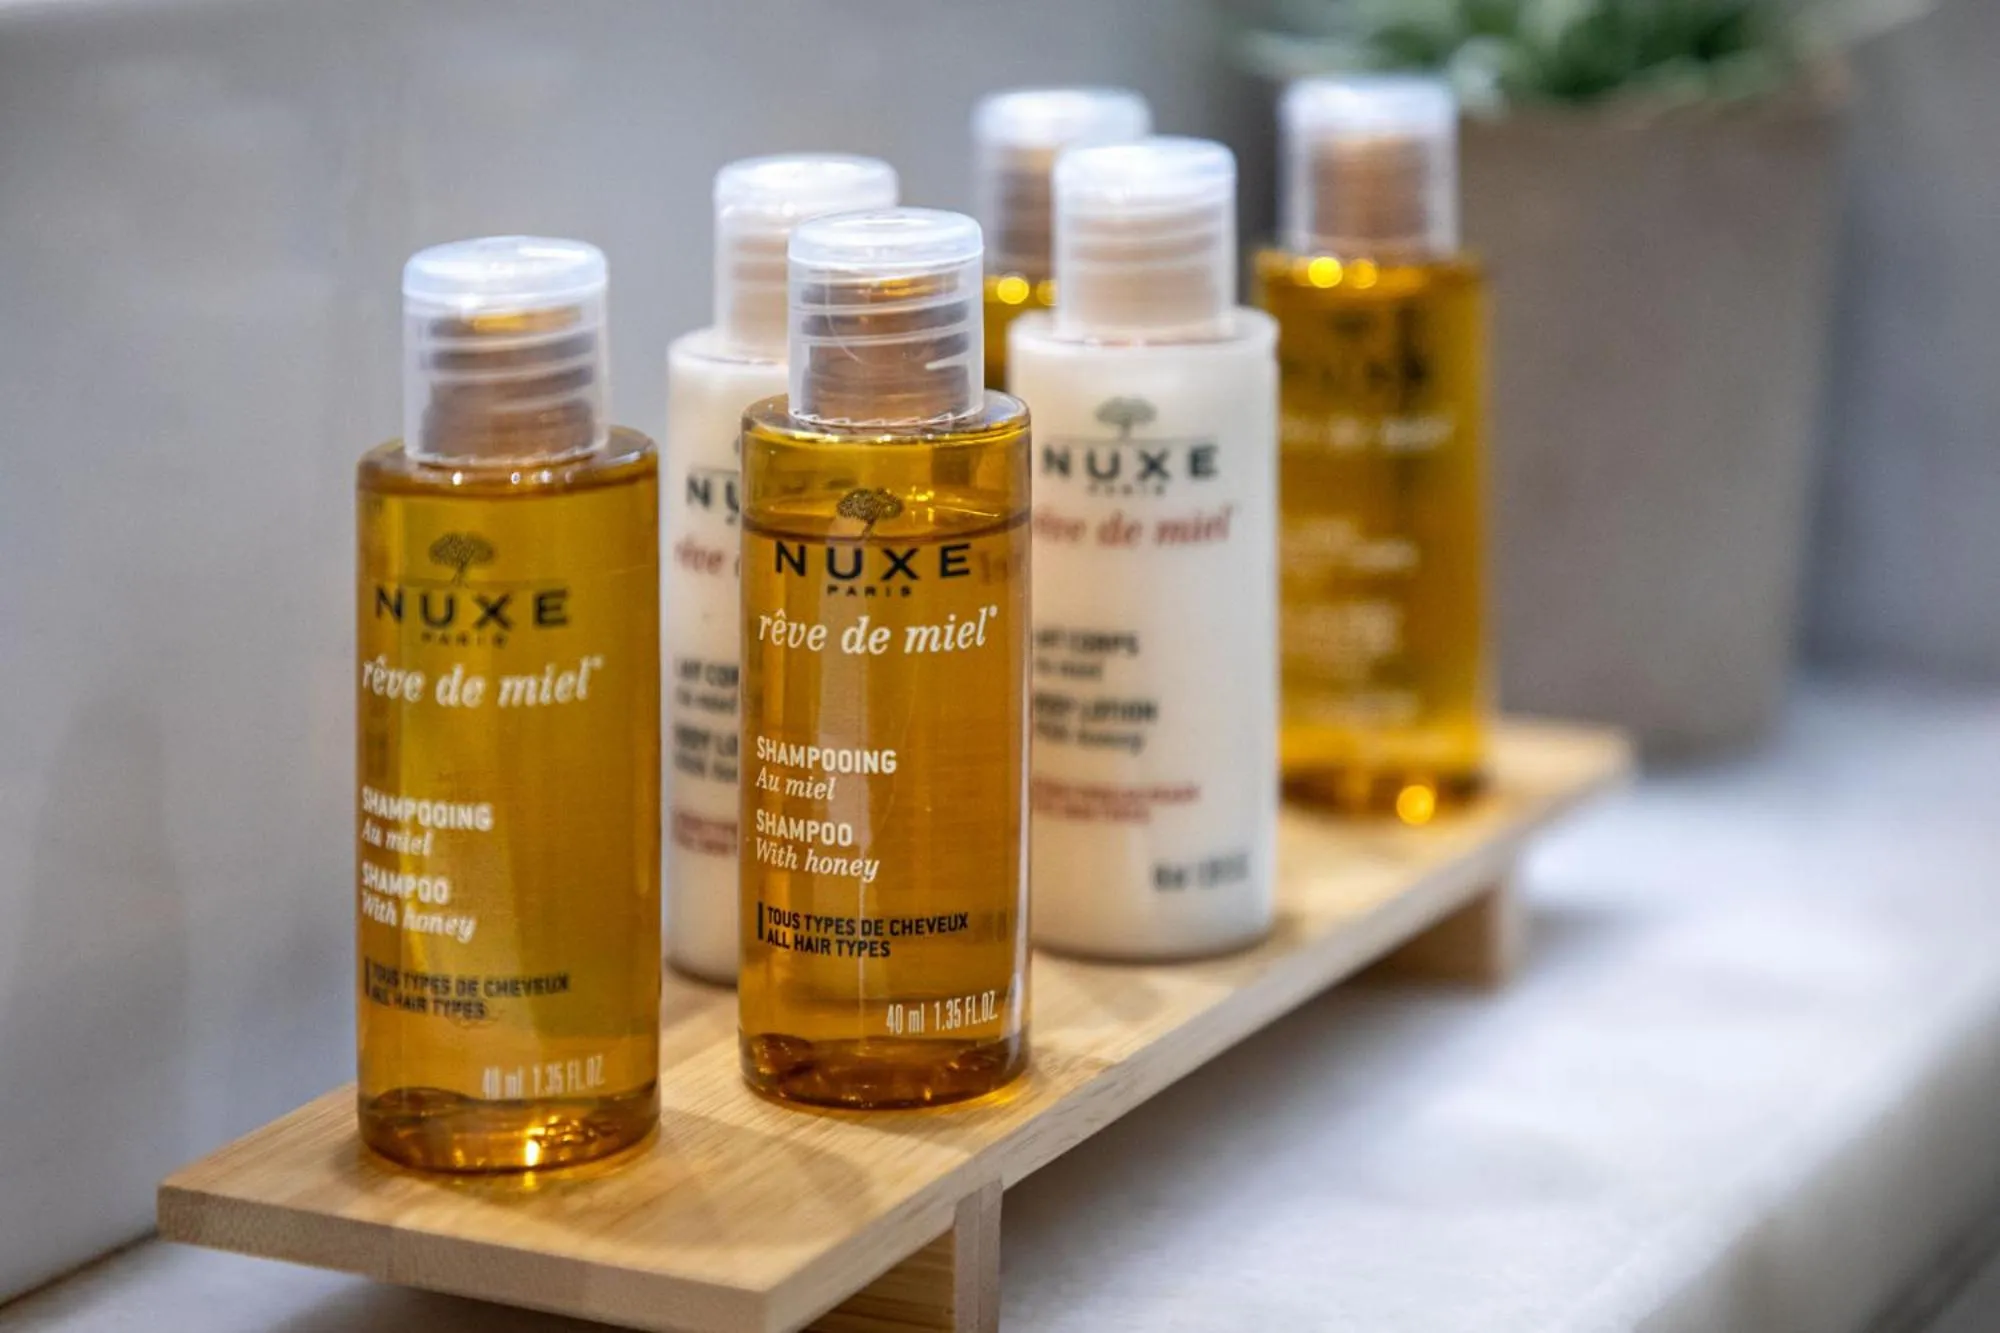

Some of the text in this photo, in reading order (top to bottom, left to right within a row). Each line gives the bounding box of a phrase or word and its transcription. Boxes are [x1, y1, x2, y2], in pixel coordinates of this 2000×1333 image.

[1043, 445, 1218, 482] NUXE
[775, 540, 971, 580] NUXE
[375, 585, 569, 629] NUXE
[827, 585, 912, 597] PARIS
[758, 608, 828, 651] rêve
[841, 615, 891, 655] de
[363, 655, 425, 702] rêve
[435, 664, 486, 708] de
[756, 735, 897, 774] SHAMPOOING
[755, 766, 780, 792] Au
[785, 776, 836, 800] miel
[362, 785, 494, 831] SHAMPOOING
[756, 808, 853, 847] SHAMPOO
[756, 837, 798, 870] With
[804, 848, 880, 883] honey
[362, 860, 450, 905] SHAMPOO
[767, 906, 969, 937] TOUS TYPES DE CHEVEUX
[766, 929, 891, 958] ALL HAIR TYPES
[886, 1004, 904, 1035] 40
[908, 1002, 925, 1034] ml
[933, 997, 962, 1032] 1.35
